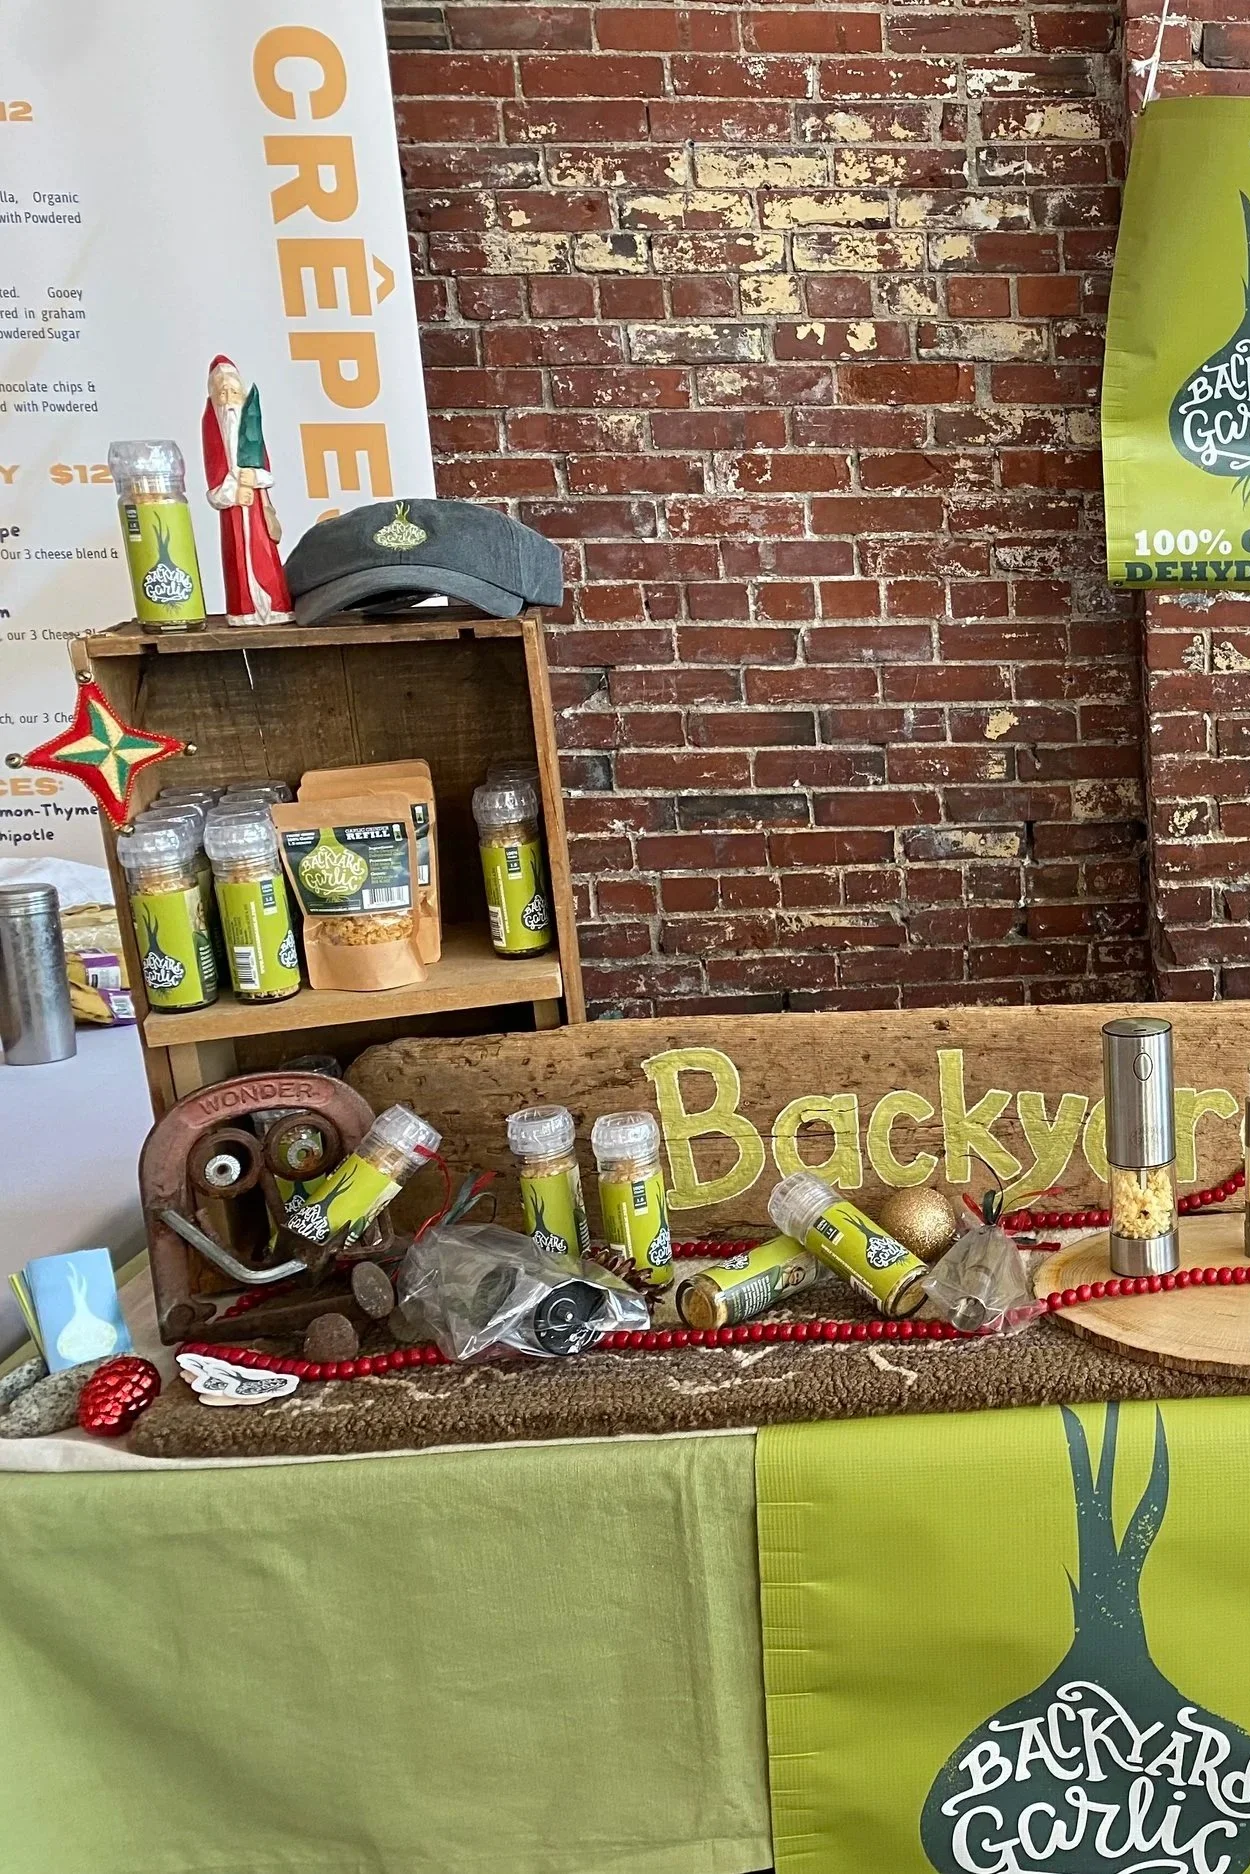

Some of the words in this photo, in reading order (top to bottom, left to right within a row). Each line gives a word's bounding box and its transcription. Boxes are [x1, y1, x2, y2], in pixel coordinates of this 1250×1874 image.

[33, 191, 80, 206] Organic
[24, 211, 82, 223] Powdered
[253, 25, 396, 520] CRÊPE
[47, 287, 83, 301] Gooey
[24, 308, 35, 319] in
[41, 308, 86, 321] graham
[47, 328, 80, 342] Sugar
[53, 381, 83, 395] chips
[88, 381, 96, 392] &
[14, 401, 39, 412] with
[42, 401, 98, 412] Powdered
[50, 463, 113, 485] $12
[1134, 528, 1232, 555] 100%
[1, 549, 20, 560] Our
[25, 549, 31, 560] 3
[35, 549, 73, 560] cheese
[76, 547, 107, 559] blend
[111, 547, 118, 559] &
[7, 632, 26, 641] our
[30, 630, 37, 641] 3
[19, 714, 38, 724] our
[43, 712, 49, 723] 3
[0, 803, 99, 821] mon-Thyme
[345, 830, 391, 840] REFILL
[305, 867, 359, 895] Garlic
[199, 1082, 313, 1115] WONDER
[951, 1776, 1239, 1874] Garlic
